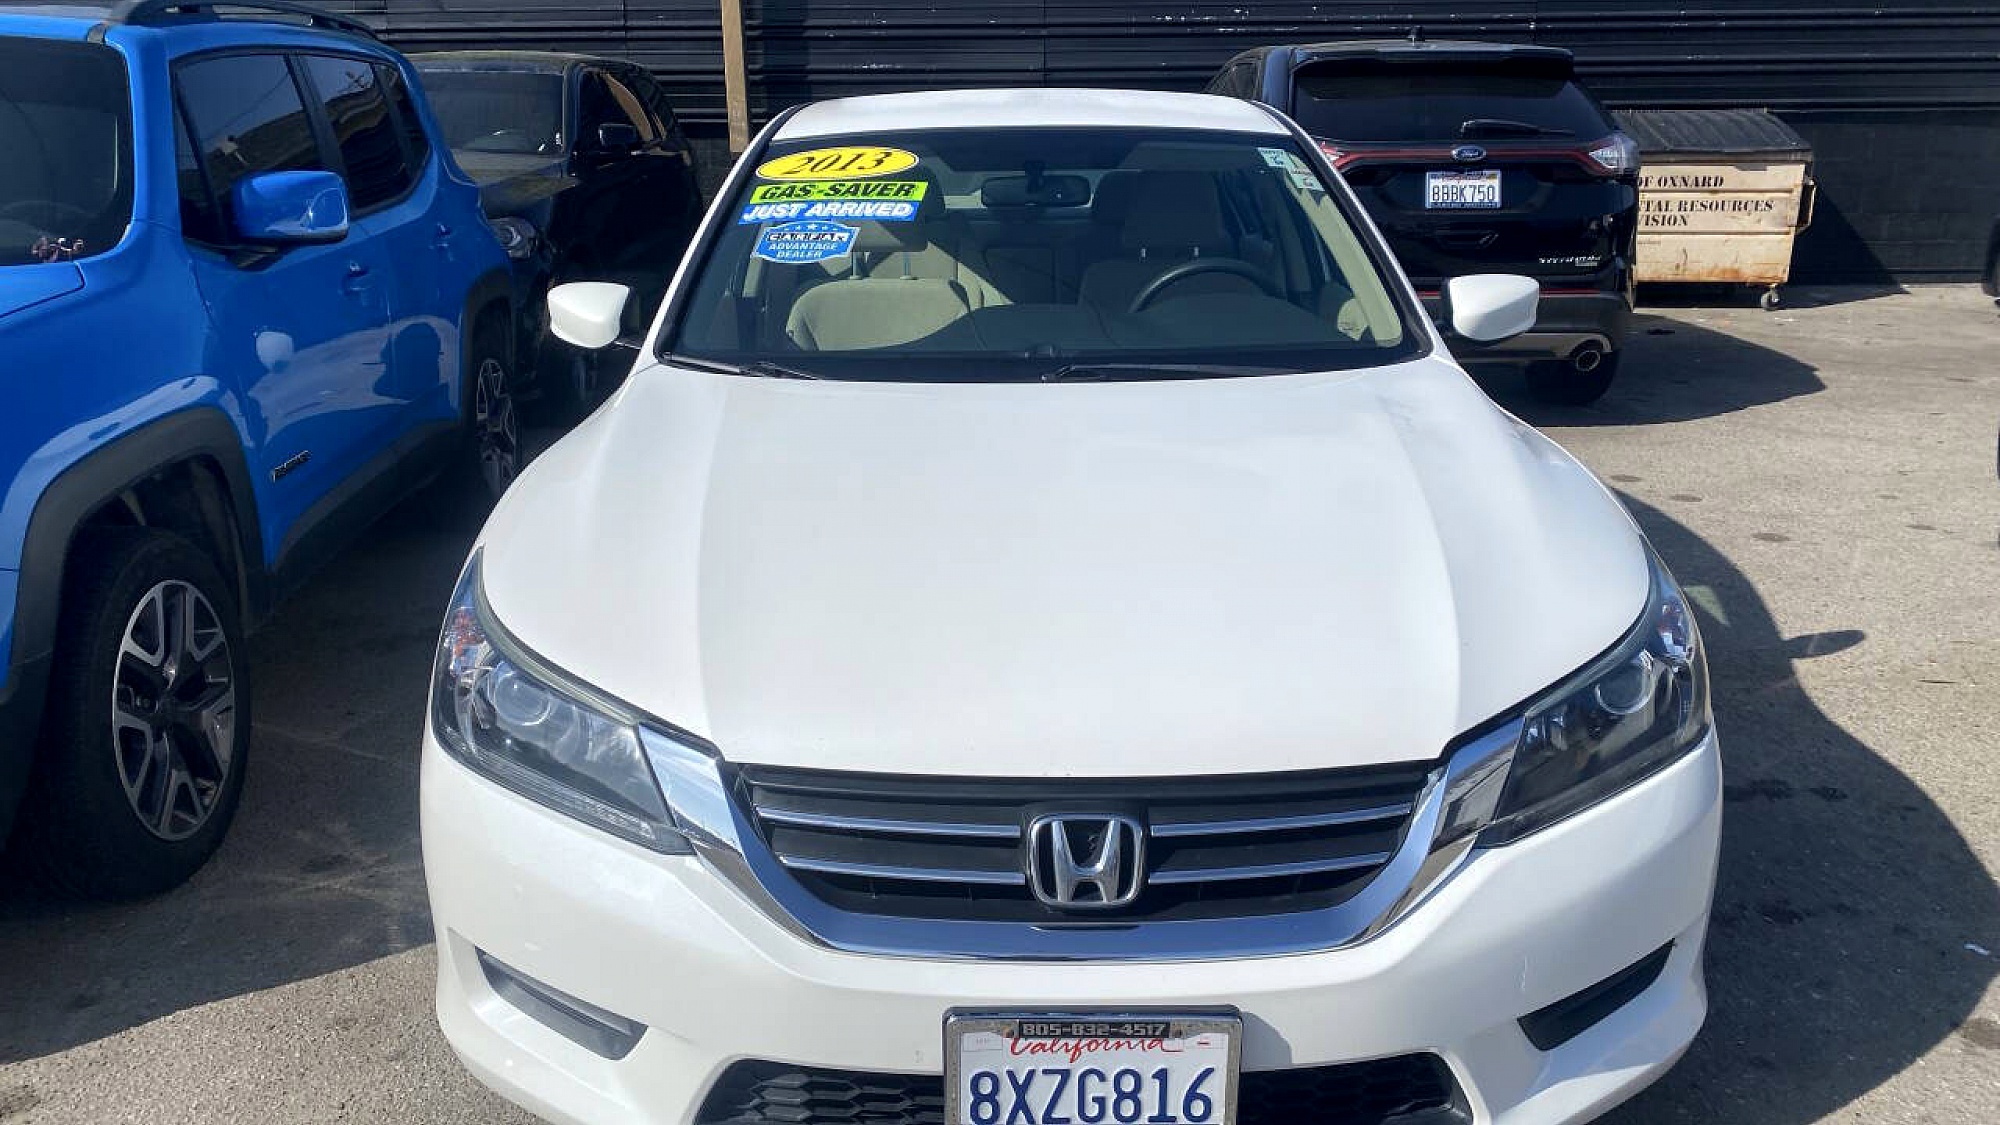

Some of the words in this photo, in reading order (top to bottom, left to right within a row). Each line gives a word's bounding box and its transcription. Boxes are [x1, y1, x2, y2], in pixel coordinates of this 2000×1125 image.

[782, 151, 893, 175] 2013
[1657, 175, 1724, 188] OXNARD
[758, 182, 917, 200] GAS-SAVER
[1432, 184, 1496, 201] 8BBK750
[743, 202, 806, 221] JUST
[805, 201, 914, 217] ARRIVED
[1677, 199, 1774, 213] RESOURCES
[768, 241, 839, 251] ADVANTAGE
[776, 250, 823, 260] DEALER
[1022, 1023, 1167, 1037] 805-832-4517
[1008, 1036, 1184, 1064] California
[969, 1066, 1216, 1125] 8XZG816
